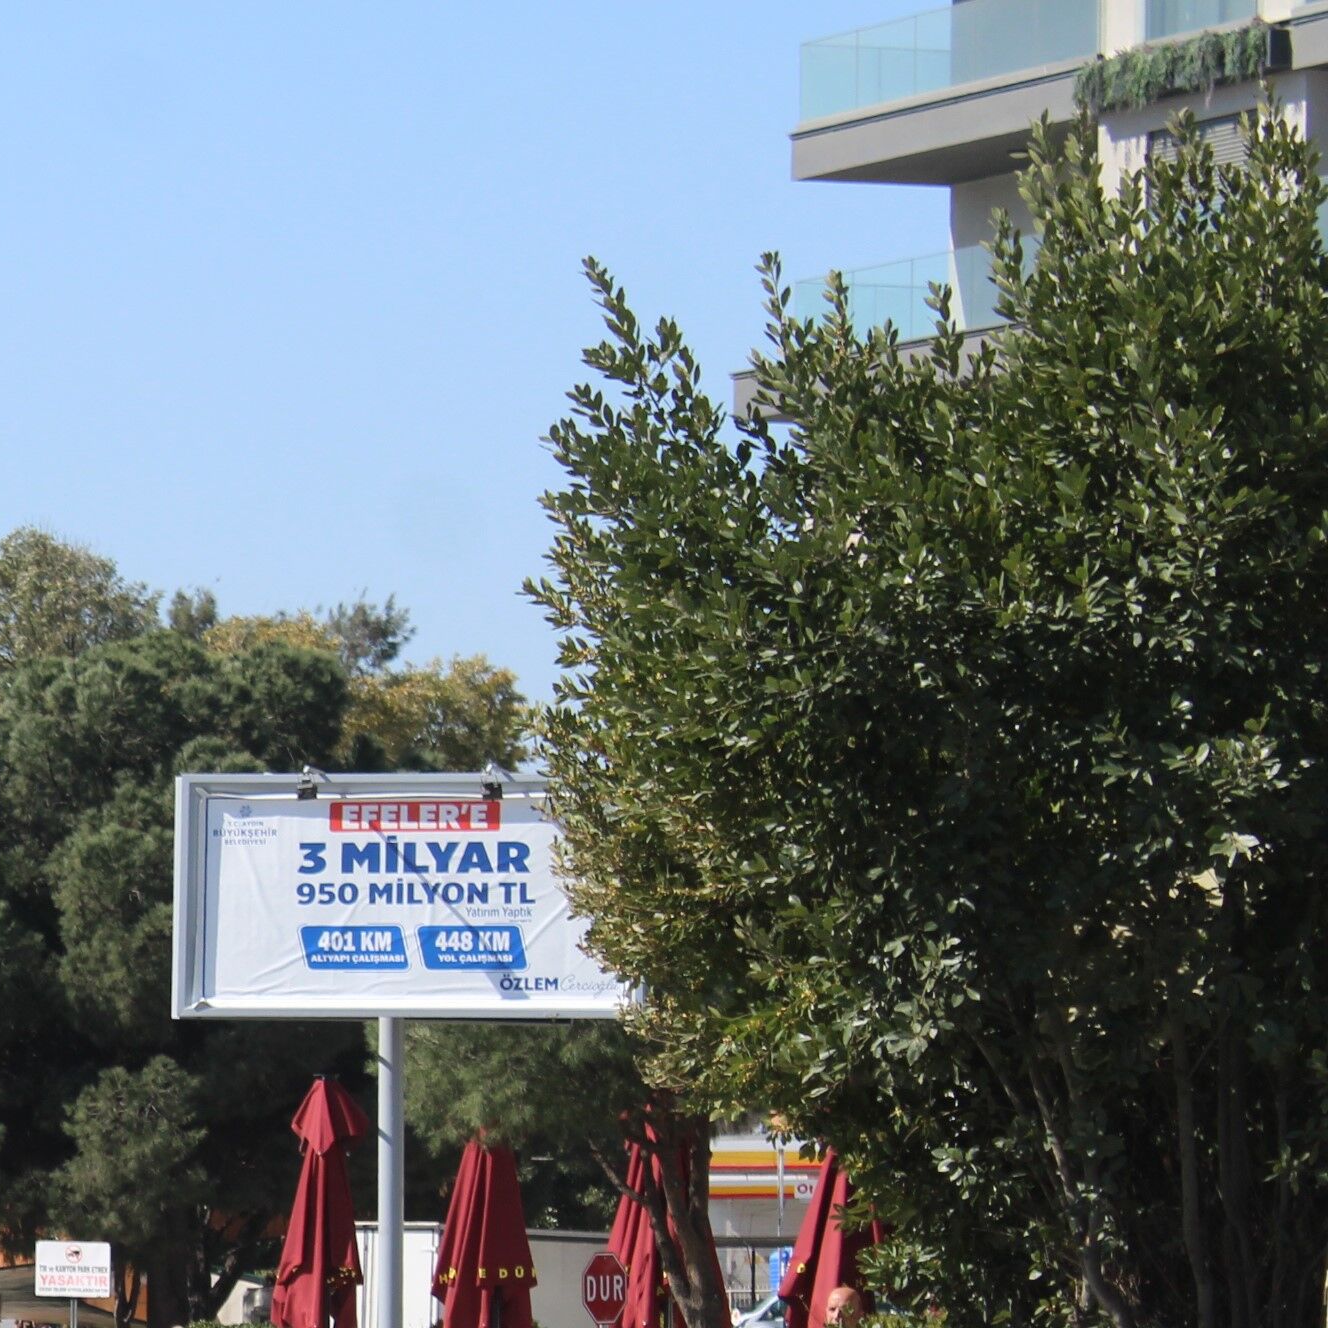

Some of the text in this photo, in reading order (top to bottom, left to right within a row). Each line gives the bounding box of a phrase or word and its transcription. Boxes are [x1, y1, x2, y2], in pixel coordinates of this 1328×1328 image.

[341, 803, 488, 830] EFELER'E
[297, 835, 531, 874] 3 MİLYAR
[296, 878, 536, 905] 950 MİLYON TL
[466, 907, 532, 919] Yatırım Yaptık
[317, 931, 392, 952] 401 KM
[434, 931, 510, 951] 448 KM
[311, 953, 405, 965] ALTYAPI ÇALIŞMASI
[438, 954, 513, 965] YOL ÇALIŞMASI
[500, 974, 559, 991] ÖZLEM
[39, 1274, 108, 1287] YASAKTIR
[586, 1275, 624, 1302] DUR
